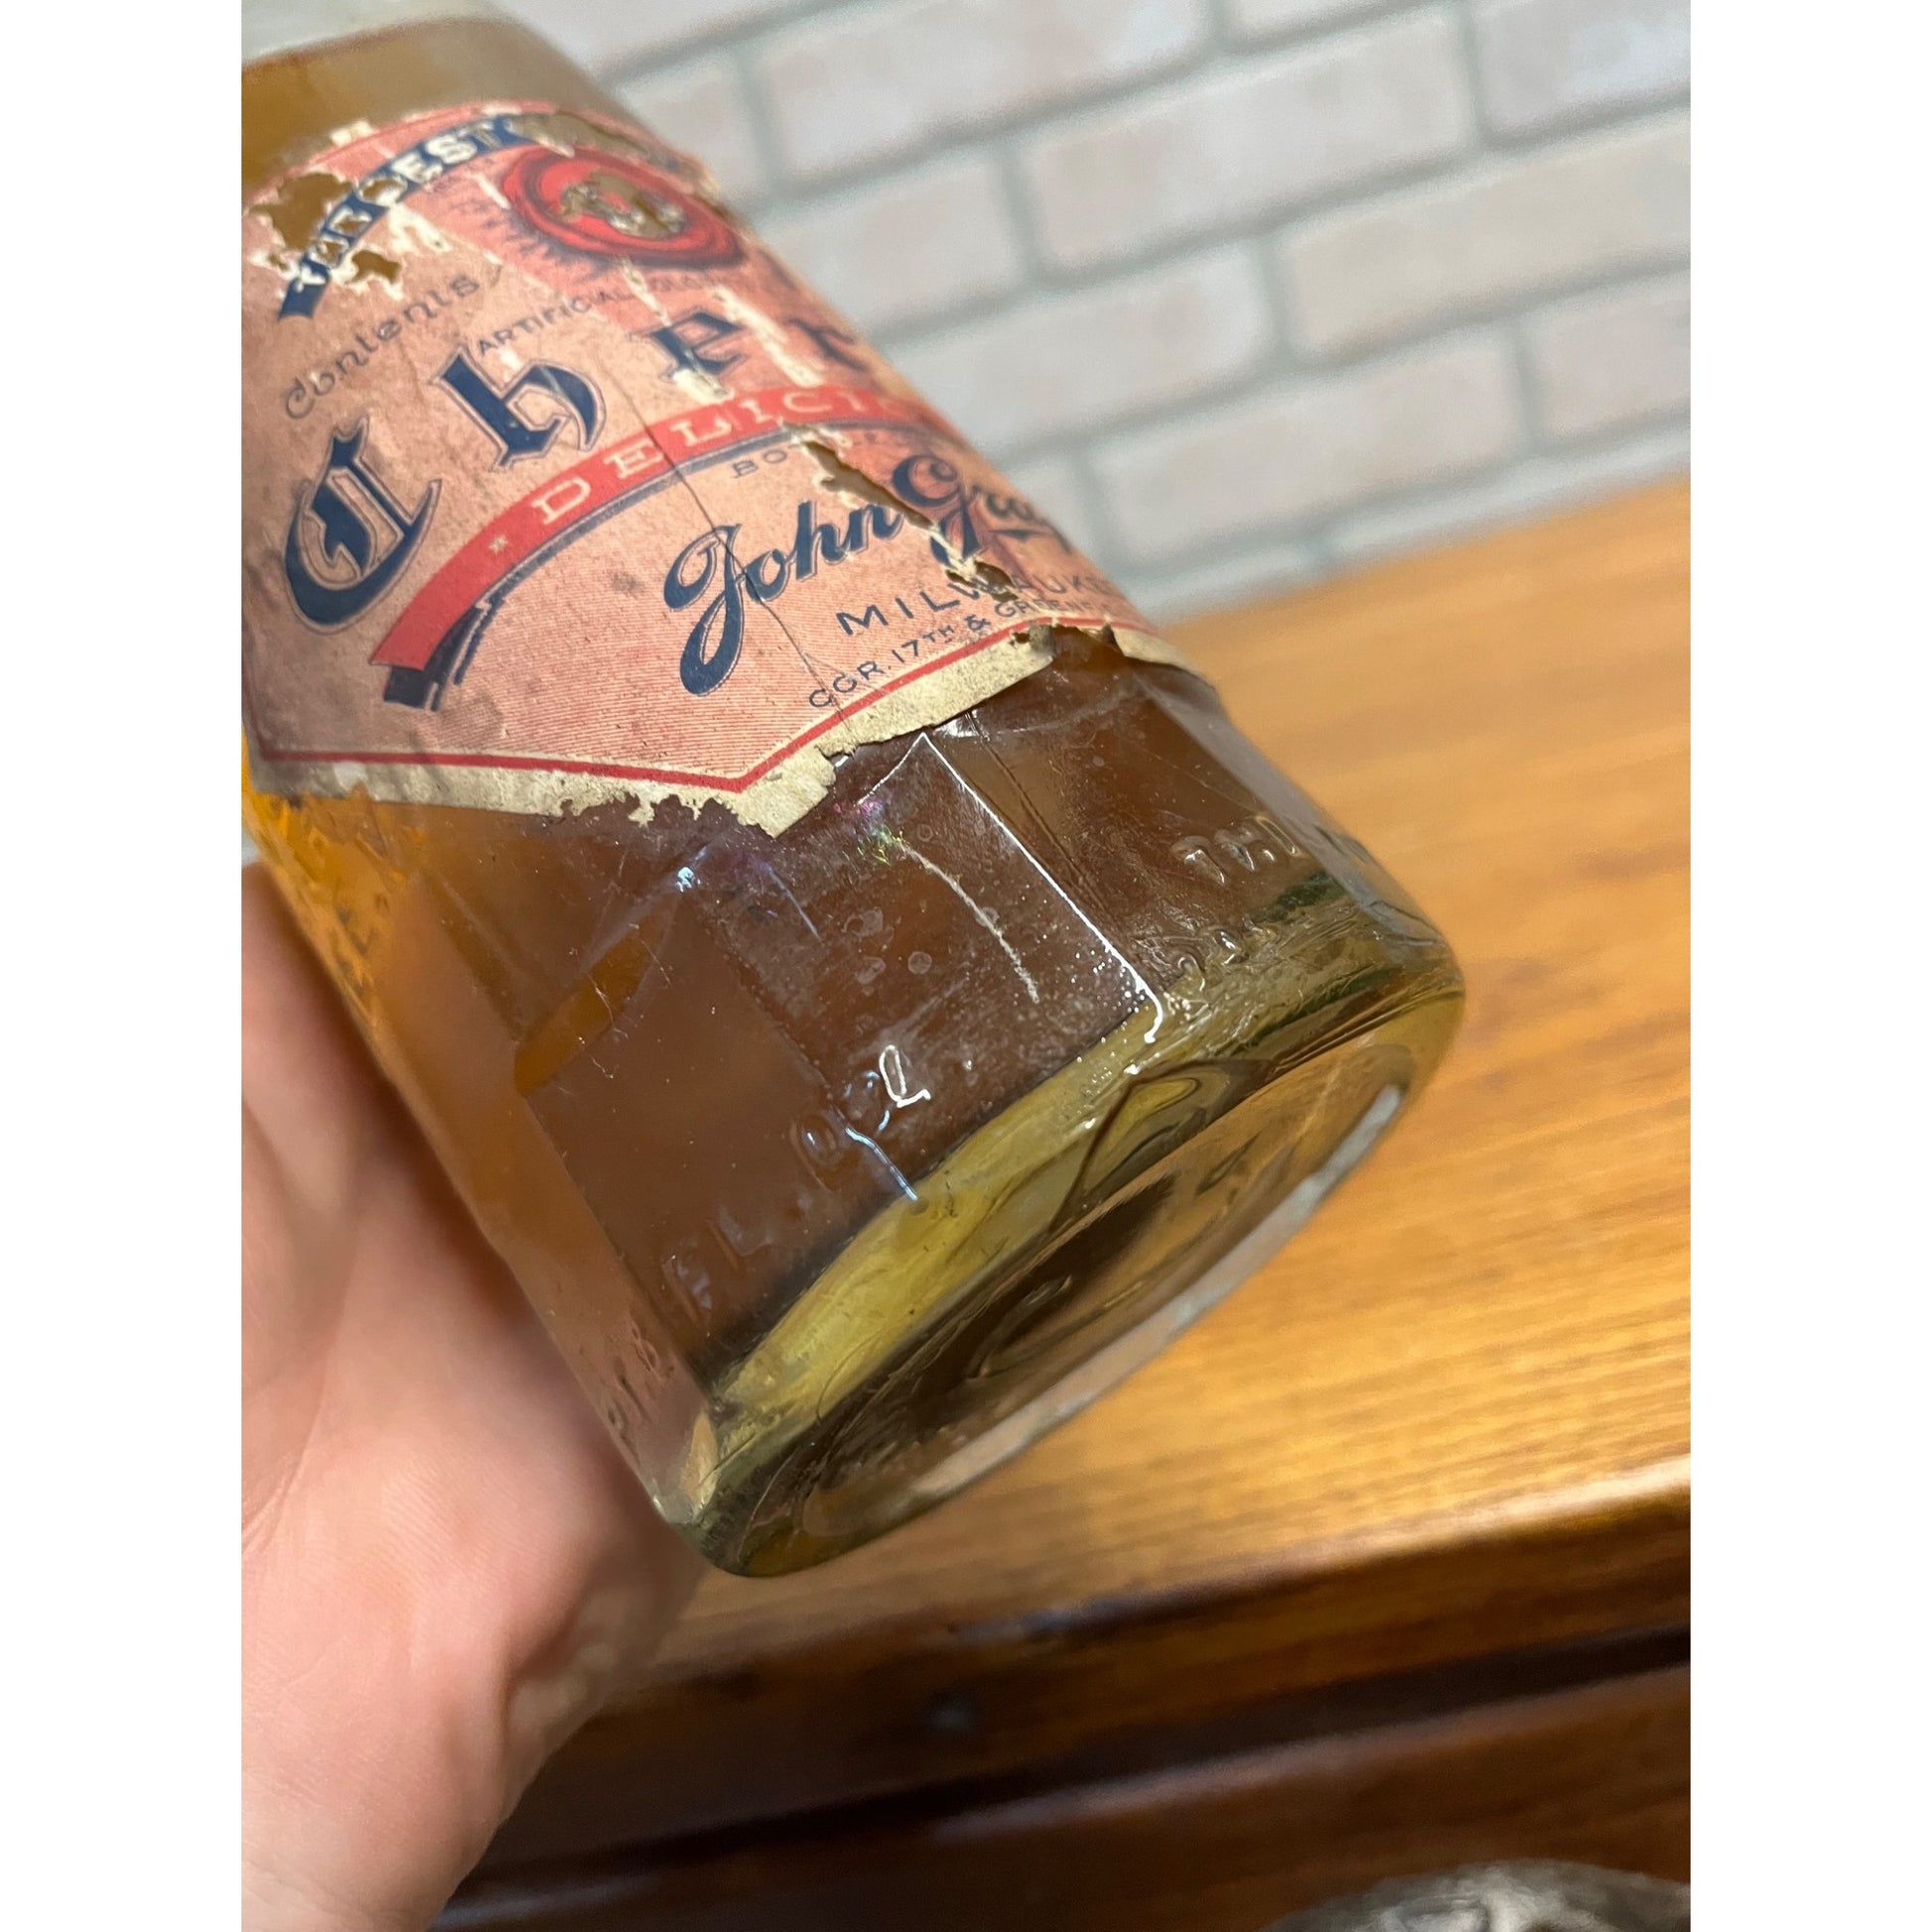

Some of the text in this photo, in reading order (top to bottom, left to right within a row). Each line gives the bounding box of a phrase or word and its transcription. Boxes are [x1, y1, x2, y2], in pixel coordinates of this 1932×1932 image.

[285, 273, 482, 420] Contents
[663, 499, 903, 697] John
[964, 614, 991, 632] &
